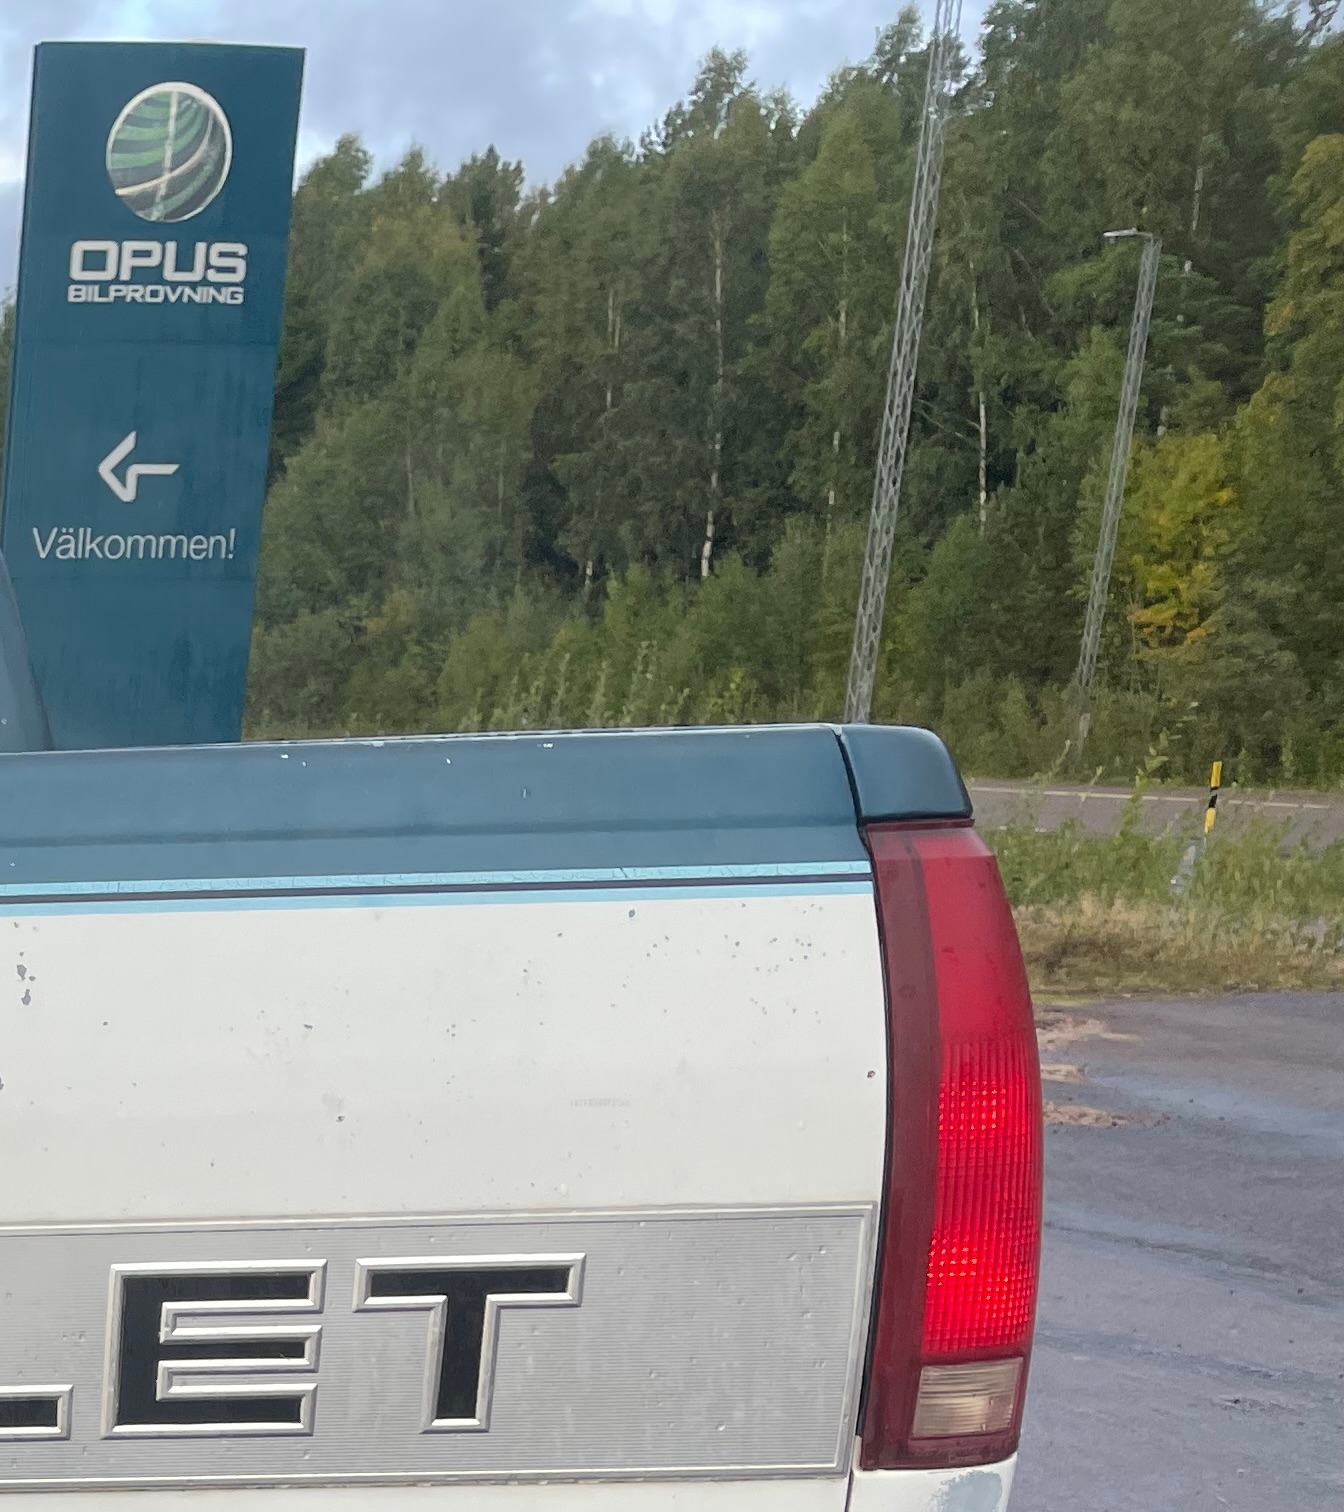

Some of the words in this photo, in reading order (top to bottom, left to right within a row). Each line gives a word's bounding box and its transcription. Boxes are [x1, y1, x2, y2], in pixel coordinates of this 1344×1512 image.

[69, 240, 248, 283] OPUS
[67, 284, 244, 305] BILPROVNING
[32, 527, 236, 560] Välkommen!
